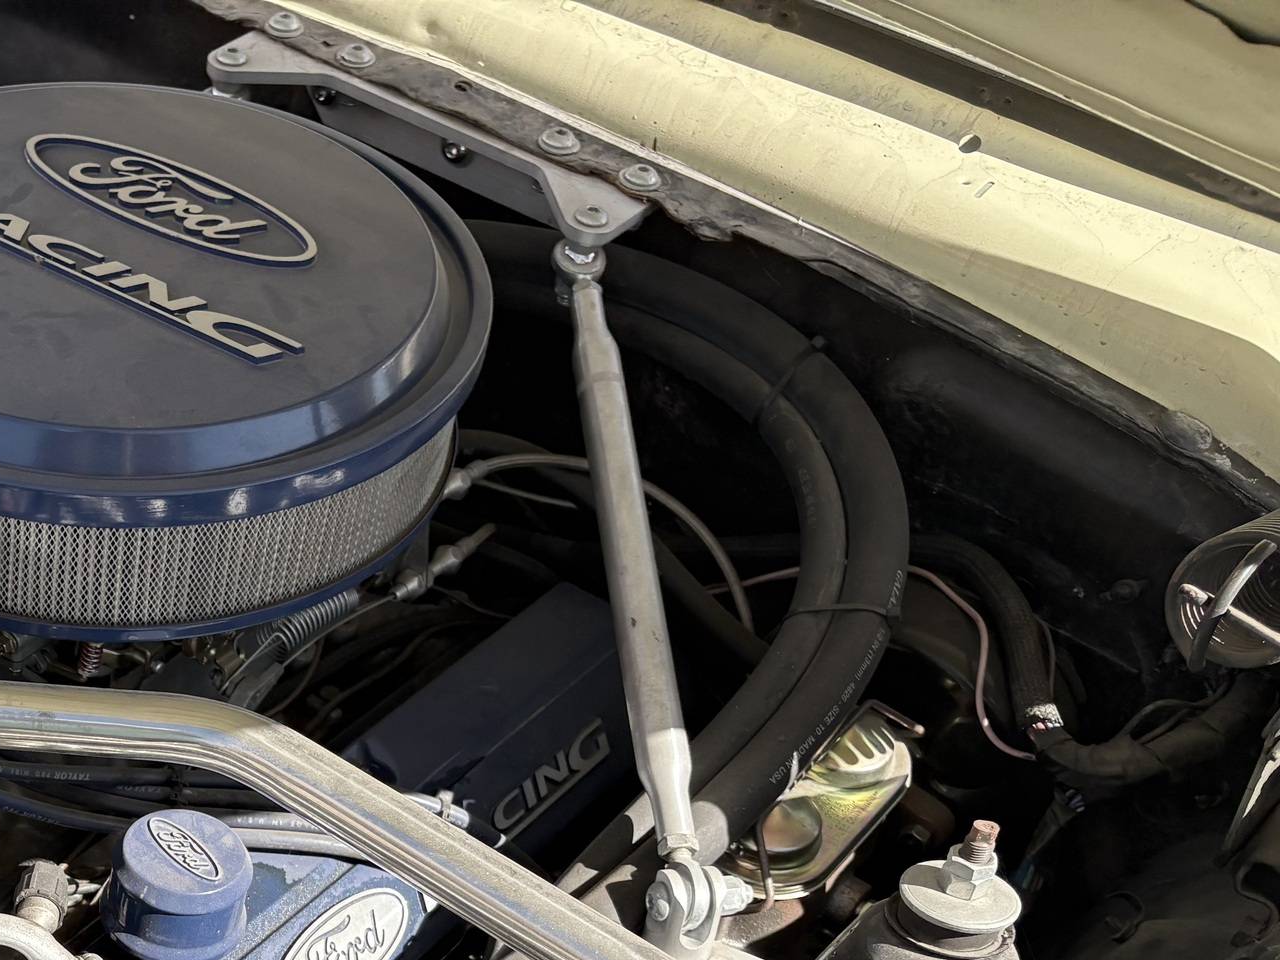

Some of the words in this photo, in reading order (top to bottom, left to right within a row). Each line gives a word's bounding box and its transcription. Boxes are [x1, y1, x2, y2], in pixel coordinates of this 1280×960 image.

[68, 155, 268, 244] Ford
[888, 569, 903, 609] GALA
[823, 705, 840, 724] SIZE
[814, 722, 825, 737] 10
[798, 734, 816, 756] MAD
[54, 771, 92, 781] TAYLOR
[493, 718, 611, 832] CING
[768, 764, 788, 787] USA
[156, 827, 210, 873] Ford
